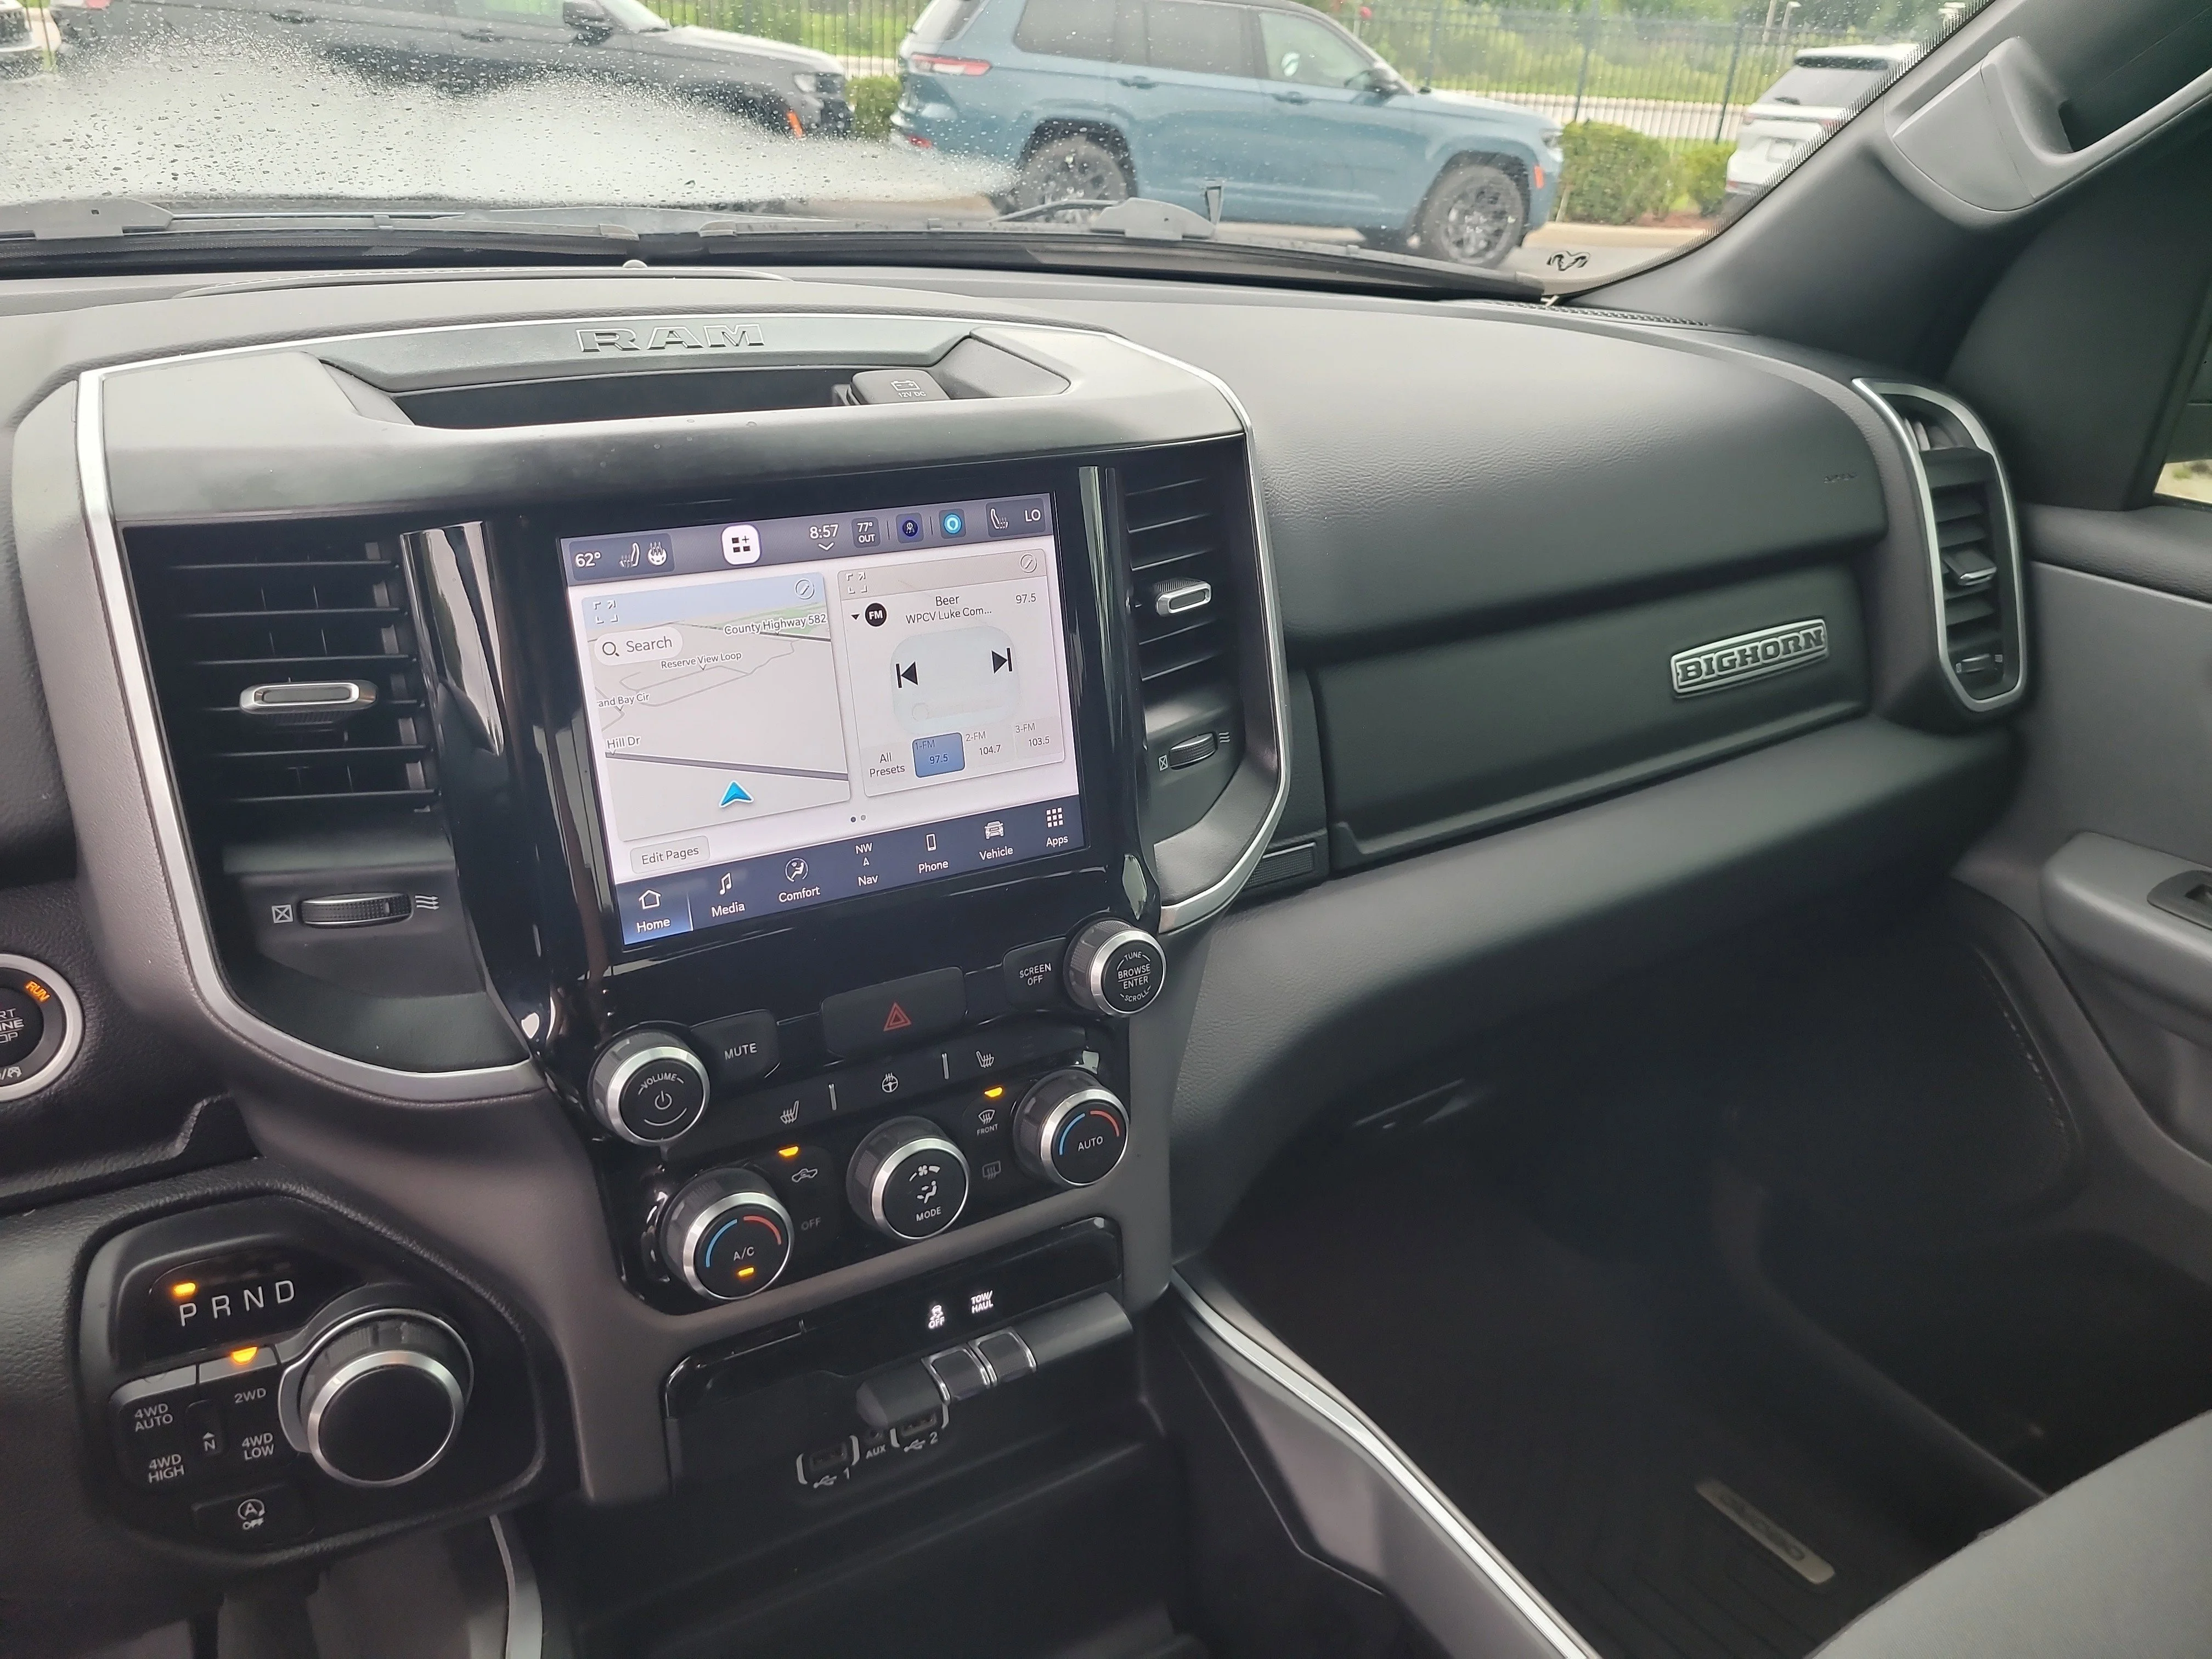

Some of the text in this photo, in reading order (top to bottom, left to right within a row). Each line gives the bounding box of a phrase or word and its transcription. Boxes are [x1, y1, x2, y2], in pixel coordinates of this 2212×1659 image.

[576, 324, 765, 352] RAM
[1025, 509, 1041, 522] LO
[809, 524, 839, 539] 8:57
[858, 534, 875, 544] OUT
[575, 552, 601, 568] 62°
[935, 596, 960, 606] Beer
[1015, 593, 1036, 604] 97.5
[868, 610, 884, 620] FM
[906, 607, 992, 624] WPCV Luke Com...
[724, 614, 827, 636] County Highway 582
[626, 636, 673, 653] Search
[661, 651, 742, 669] Reserve View Loop
[1677, 626, 1825, 684] BIGHORN
[597, 693, 650, 707] and Bay Cir
[1015, 723, 1035, 733] 3-FM
[607, 736, 640, 749] Hill Dr
[966, 731, 986, 742] 2-FM
[1028, 736, 1050, 747] 103.5
[915, 740, 935, 751] 1-FM
[979, 744, 1001, 756] 104.7
[879, 752, 892, 763] All
[929, 754, 948, 765] 97.5
[870, 764, 905, 778] Presets
[855, 843, 873, 854] NW
[1046, 835, 1068, 849] Apps
[642, 847, 699, 865] Edit Pages
[979, 847, 1013, 860] Vehicle
[918, 860, 949, 874] Phone
[857, 875, 878, 887] Nav
[778, 885, 821, 903] Comfort
[712, 901, 745, 917] Media
[636, 917, 670, 933] Home
[1124, 951, 1142, 961] TUNE
[1019, 963, 1052, 978] SCREEN
[1118, 964, 1150, 980] BROWSE
[1027, 974, 1043, 986] OFF
[1123, 976, 1149, 989] ENTER
[26, 981, 50, 1001] RUN
[1124, 990, 1149, 1002] SCROLL
[724, 1042, 757, 1060] MUTE
[641, 1073, 678, 1090] VOLUME
[977, 1124, 998, 1136] FRONT
[1077, 1136, 1103, 1152] AUTO
[916, 1206, 941, 1222] MODE
[801, 1217, 821, 1231] OFF
[733, 1246, 755, 1262] A/C
[179, 1279, 295, 1327] P R N D
[970, 1290, 994, 1306] TOW/
[972, 1299, 994, 1314] HAUL
[928, 1316, 945, 1329] OFF
[234, 1387, 267, 1403] 2WD
[134, 1403, 169, 1420] 4WD
[135, 1414, 174, 1432] AUTO
[204, 1439, 216, 1452] N
[241, 1432, 274, 1448] 4WD
[930, 1431, 938, 1445] 2
[244, 1444, 274, 1460] LOW
[866, 1444, 887, 1459] AUX
[149, 1453, 182, 1470] 4WD
[148, 1465, 185, 1483] HIGH
